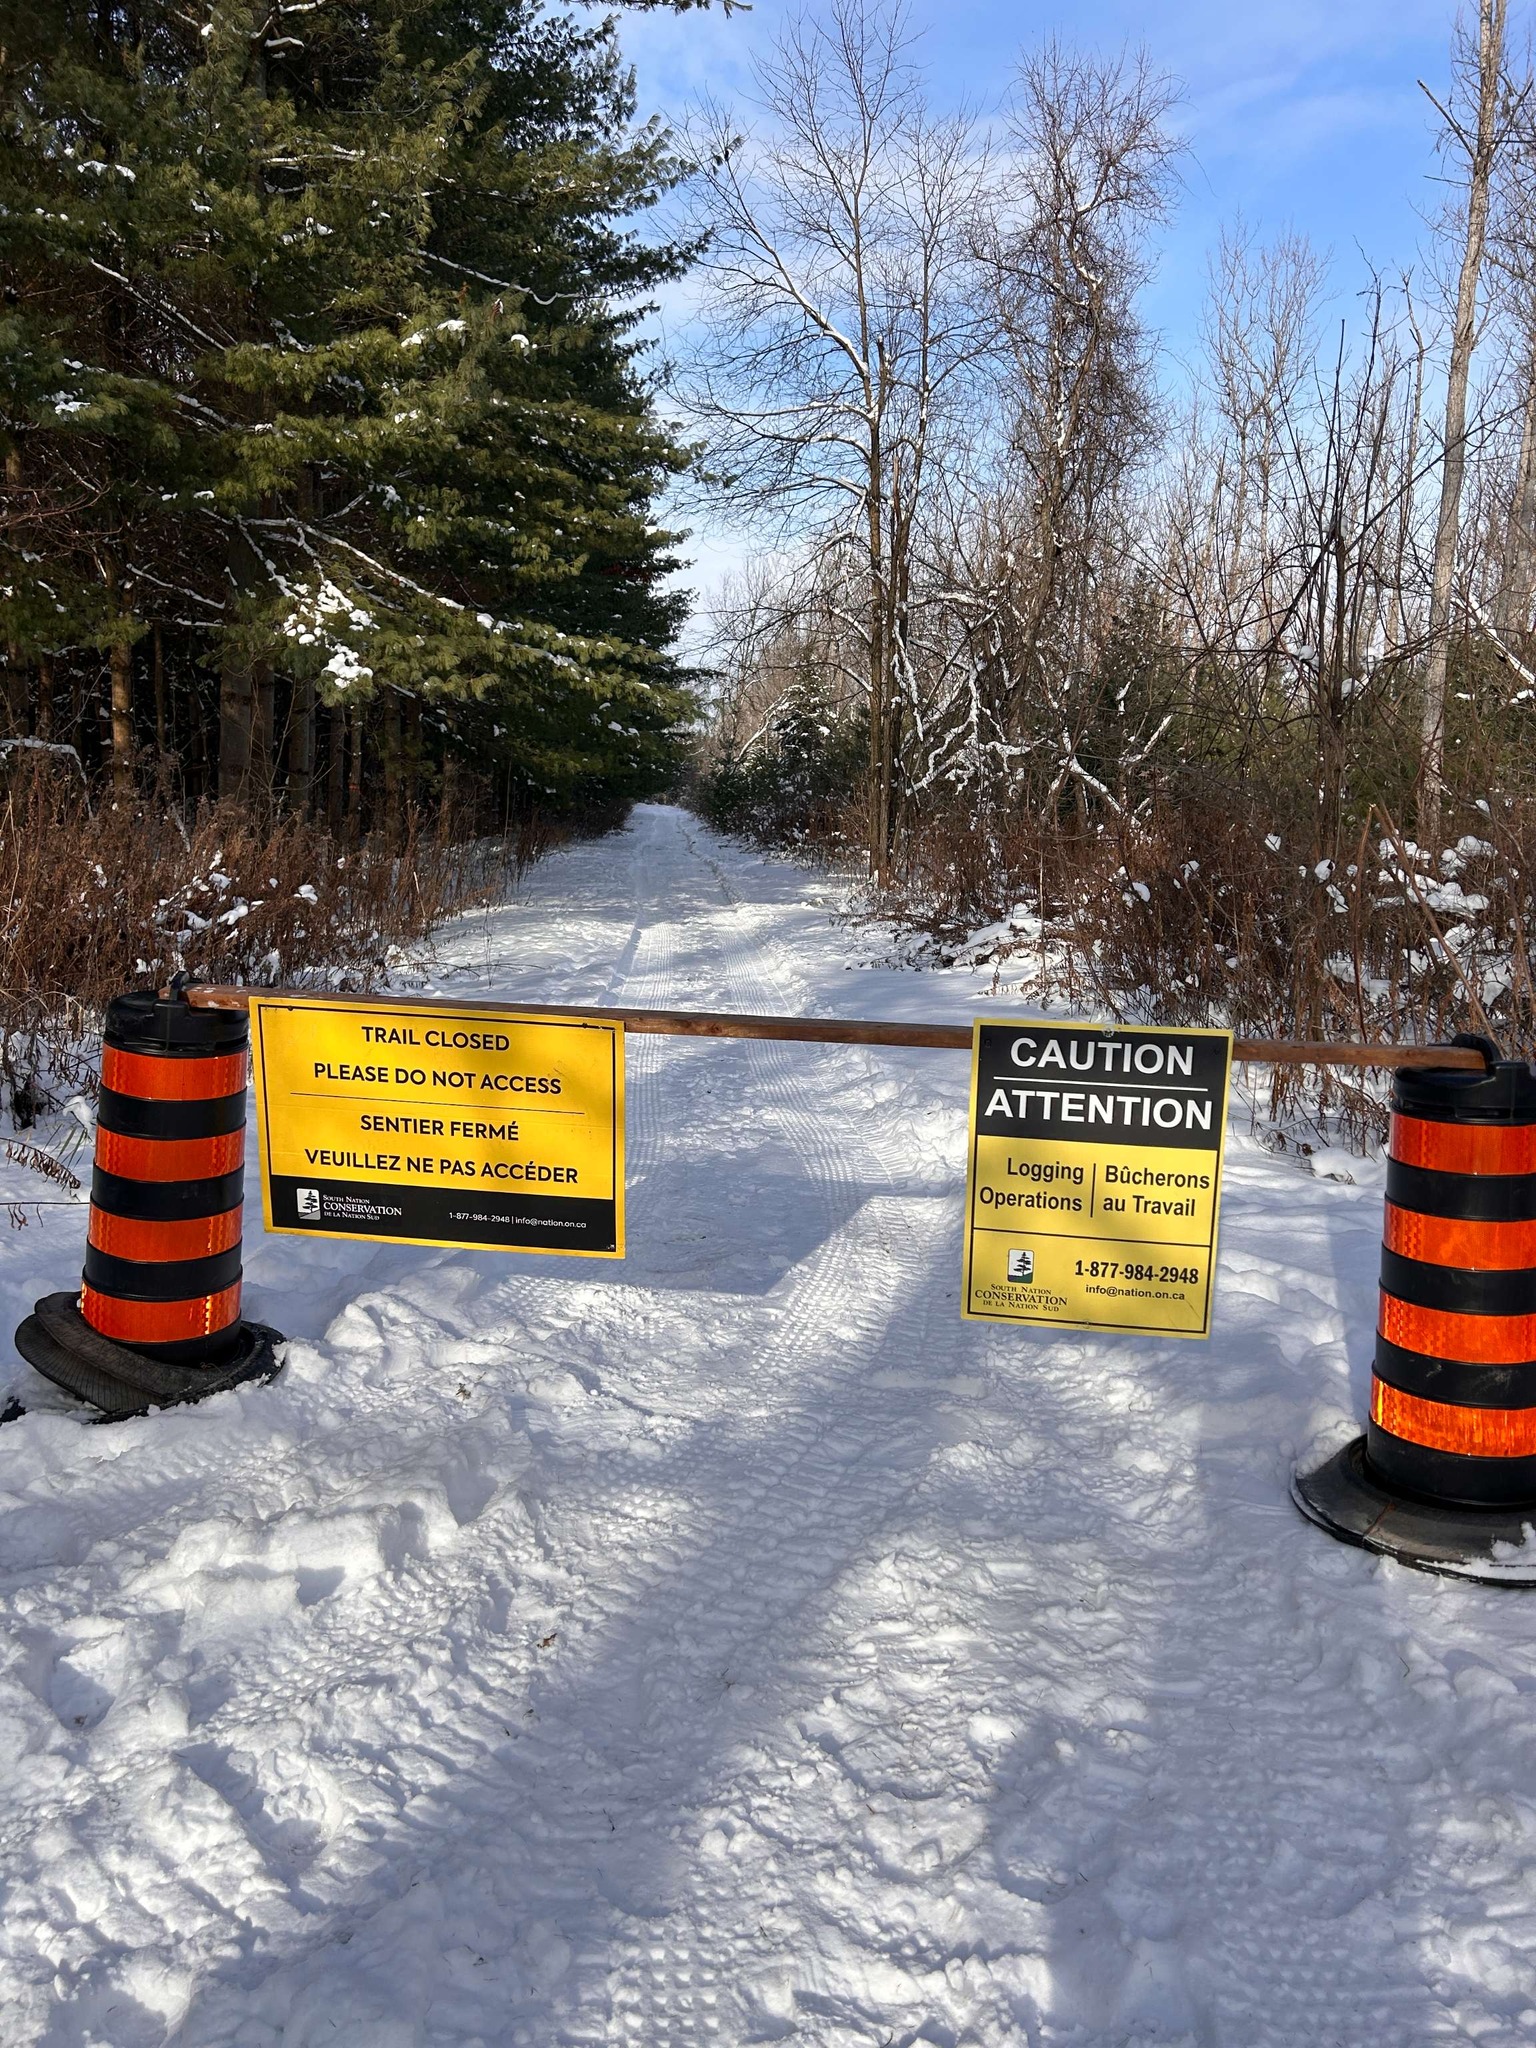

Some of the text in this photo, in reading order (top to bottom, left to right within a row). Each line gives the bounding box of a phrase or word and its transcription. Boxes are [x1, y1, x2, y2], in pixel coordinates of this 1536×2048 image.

[361, 1026, 510, 1051] TRAIL CLOSED
[1010, 1037, 1194, 1076] CAUTION
[314, 1062, 562, 1095] PLEASE DO NOT ACCESS
[984, 1088, 1213, 1131] ATTENTION
[360, 1114, 519, 1141] SENTIER FERMÉ
[304, 1148, 579, 1184] VEUILLEZ NE PAS ACCÉDER
[1007, 1157, 1084, 1185] Logging
[1105, 1165, 1210, 1190] Bûcherons
[323, 1202, 402, 1216] CONSERVATION
[979, 1186, 1083, 1212] Operations
[1103, 1195, 1196, 1217] au Travail
[449, 1212, 587, 1229] 1-877-984-2948 info@nation.on.ca
[1075, 1260, 1199, 1284] 1-877-984-2948
[975, 1289, 1068, 1306] CONSERVATION
[1085, 1284, 1185, 1300] info@nation.on.ca
